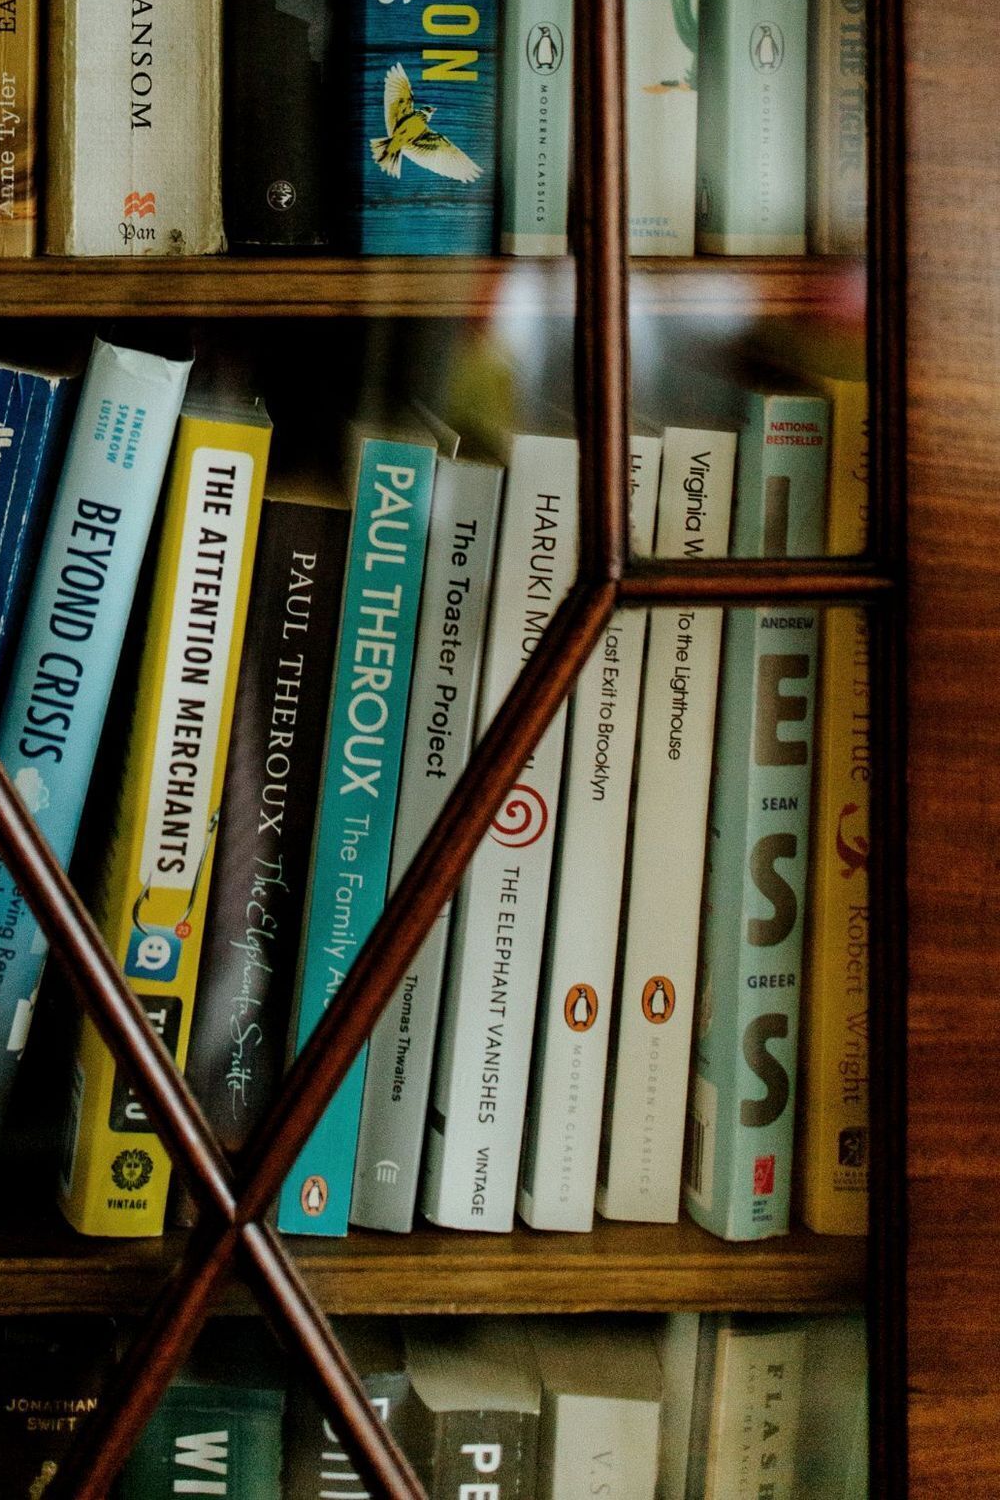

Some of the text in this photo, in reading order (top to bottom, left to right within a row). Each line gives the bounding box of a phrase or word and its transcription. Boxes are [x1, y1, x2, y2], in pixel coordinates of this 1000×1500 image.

[118, 222, 156, 243] Pan
[765, 434, 823, 447] BESTSELLER
[770, 421, 820, 433] NATIONAL
[683, 451, 711, 533] Virginia
[529, 493, 561, 601] HARUKI
[19, 498, 122, 766] BEYOND CRISIS
[157, 465, 236, 875] THE ATTENTION MERCHANTS
[340, 463, 416, 798] PAUL THEROUX
[425, 519, 478, 780] The Toaster Project
[761, 617, 813, 630] ANDREW
[257, 550, 318, 837] PAUL THEROUX
[590, 626, 623, 802] Last Exit to Brooklyn
[666, 662, 690, 761] Lighthouse
[762, 797, 798, 811] SEAN
[477, 865, 520, 1124] THE ELEPHANT VANISHES
[747, 974, 796, 989] GREER
[391, 974, 418, 1102] Thomas Thwaites
[107, 1198, 148, 1210] VINTAGE
[470, 1146, 490, 1217] VINTAGE
